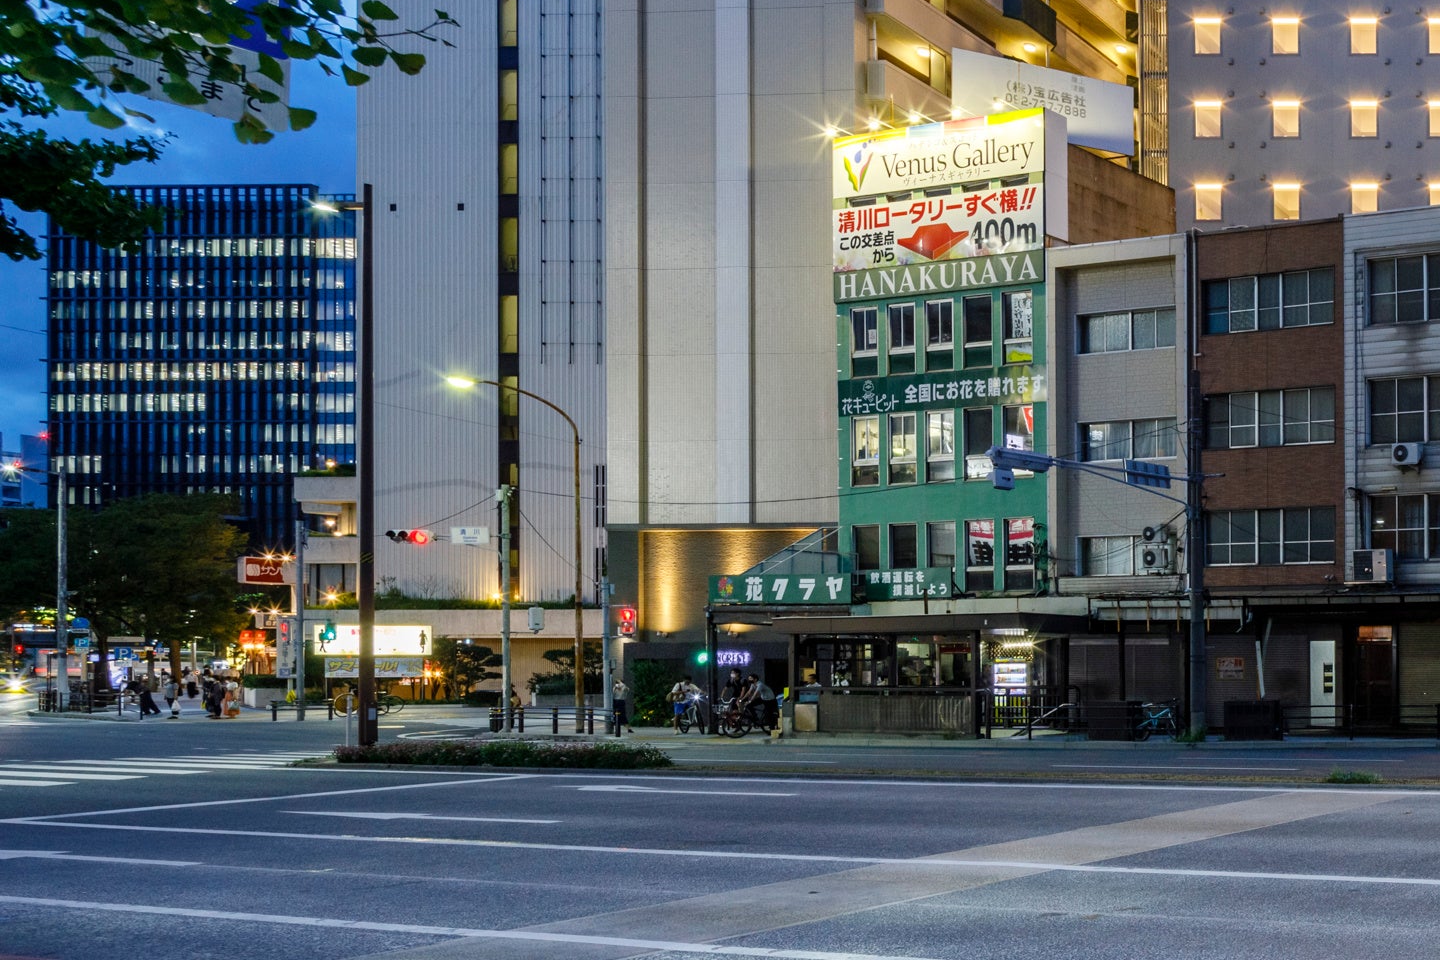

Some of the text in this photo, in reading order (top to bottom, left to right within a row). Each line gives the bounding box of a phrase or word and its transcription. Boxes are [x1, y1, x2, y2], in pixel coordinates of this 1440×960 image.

[882, 139, 1035, 179] Venus Gallery
[903, 167, 990, 186] ヴィーナスギャラリー
[838, 187, 1037, 234] 清川ロータリーすぐ横!!
[839, 230, 895, 251] この交差点
[971, 217, 1037, 250] 400m
[872, 248, 895, 264] から
[839, 253, 1039, 300] HANAKURAYA
[904, 373, 1045, 404] 全国にお花を贈れます
[841, 393, 899, 415] 花キューピット
[870, 571, 925, 584] 飲酒運転を
[745, 576, 844, 602] 花クラヤ
[892, 583, 949, 597] 撲滅しよう
[119, 648, 129, 659] P
[328, 661, 399, 672] サマーール!
